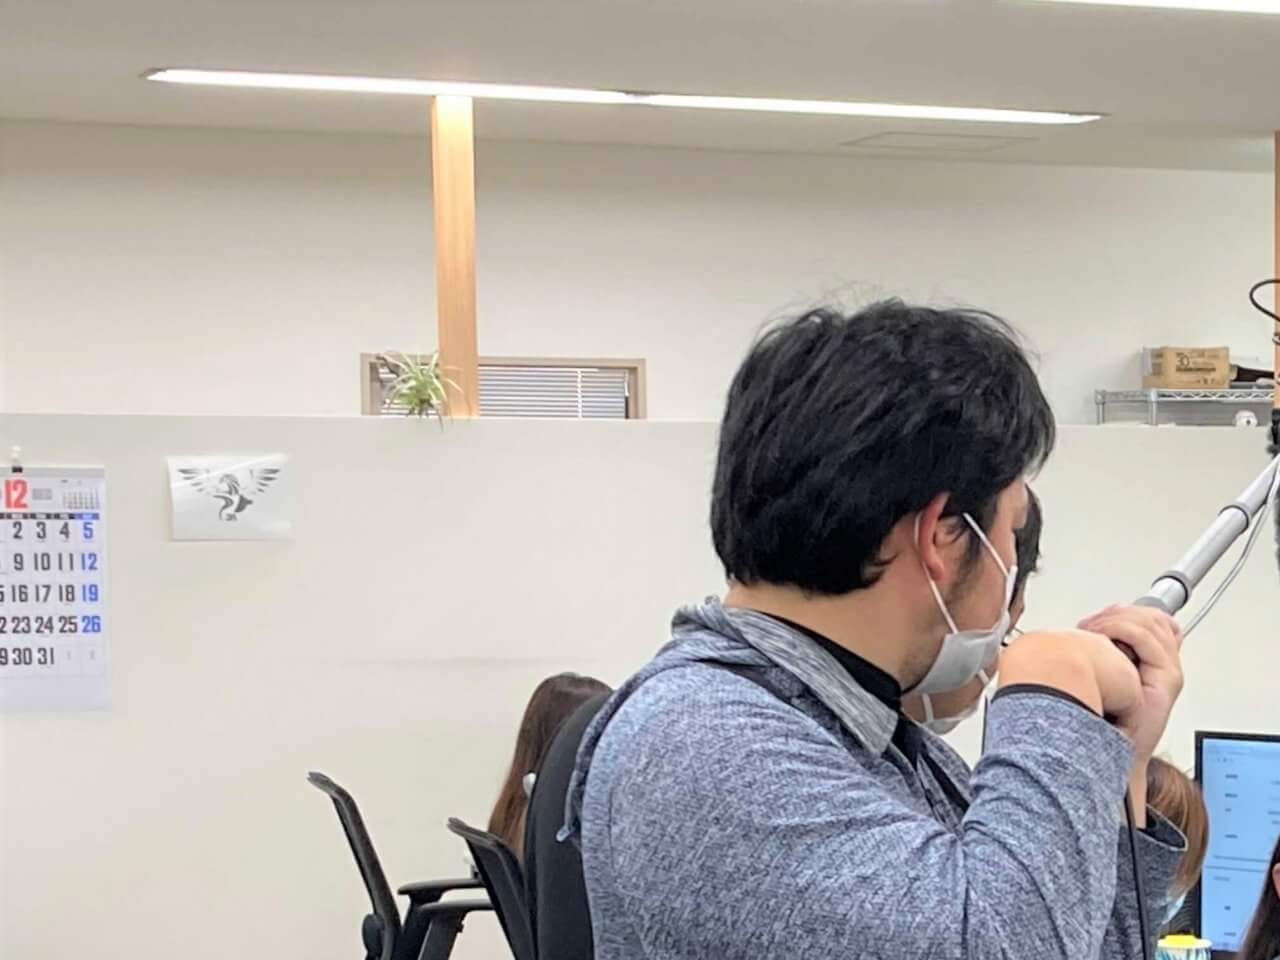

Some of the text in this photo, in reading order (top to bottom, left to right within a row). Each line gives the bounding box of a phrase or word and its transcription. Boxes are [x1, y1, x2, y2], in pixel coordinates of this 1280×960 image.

[5, 480, 28, 508] 12
[13, 521, 93, 539] 2 3 4 5
[14, 553, 98, 571] 9 10 11 12
[11, 584, 28, 602] 16
[35, 584, 51, 602] 17
[59, 584, 75, 602] 18
[82, 584, 98, 602] 19
[11, 616, 31, 634] 23
[35, 616, 54, 634] 24
[58, 616, 78, 634] 25
[82, 616, 101, 634] 26
[0, 648, 8, 665] 9
[12, 648, 32, 665] 30
[37, 648, 54, 665] 31
